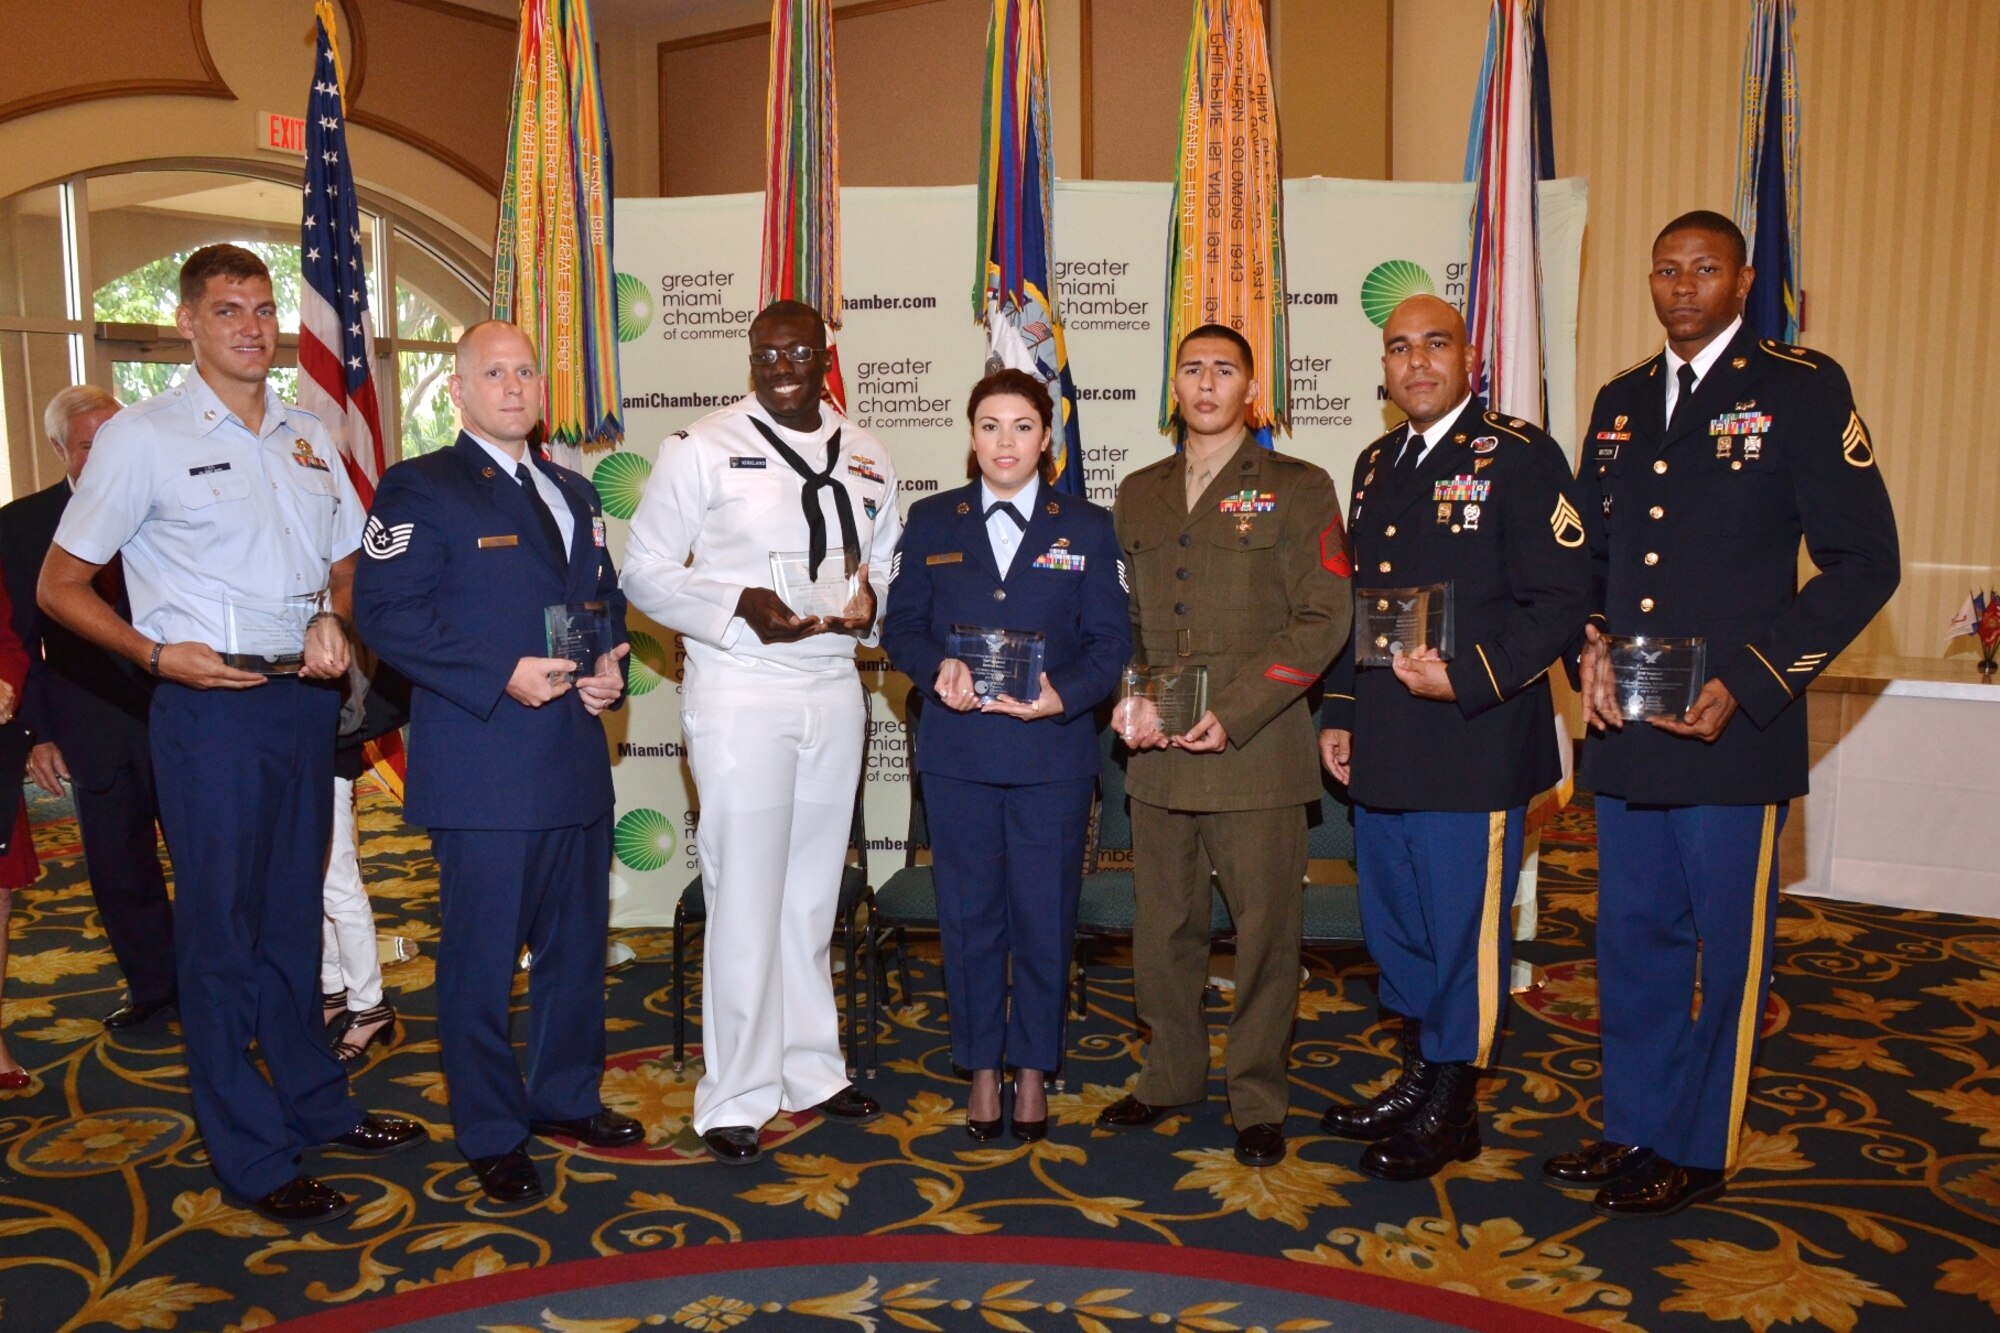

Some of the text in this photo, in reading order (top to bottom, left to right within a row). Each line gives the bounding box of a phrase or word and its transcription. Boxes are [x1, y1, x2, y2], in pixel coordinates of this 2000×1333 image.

[270, 114, 304, 152] EXIT
[1231, 135, 1245, 230] SOLOMONS
[590, 154, 604, 246] AISNE 1918
[1183, 181, 1197, 227] HUNT
[1055, 258, 1130, 280] greater
[1231, 243, 1244, 283] 1943
[661, 270, 735, 292] greater
[1057, 278, 1115, 295] miami
[662, 289, 721, 307] miami
[841, 294, 937, 311] hamber.com
[1059, 298, 1149, 315] chamber
[662, 307, 755, 326] chamber
[1071, 320, 1151, 331] commerce
[663, 328, 747, 340] of commerc
[857, 357, 932, 379] greater
[1289, 355, 1332, 372] ater
[858, 376, 918, 394] miami
[858, 395, 952, 413] chamber
[858, 415, 954, 428] of commerce
[1291, 415, 1353, 426] mmerce
[1083, 464, 1115, 481] ami
[867, 770, 881, 782] of
